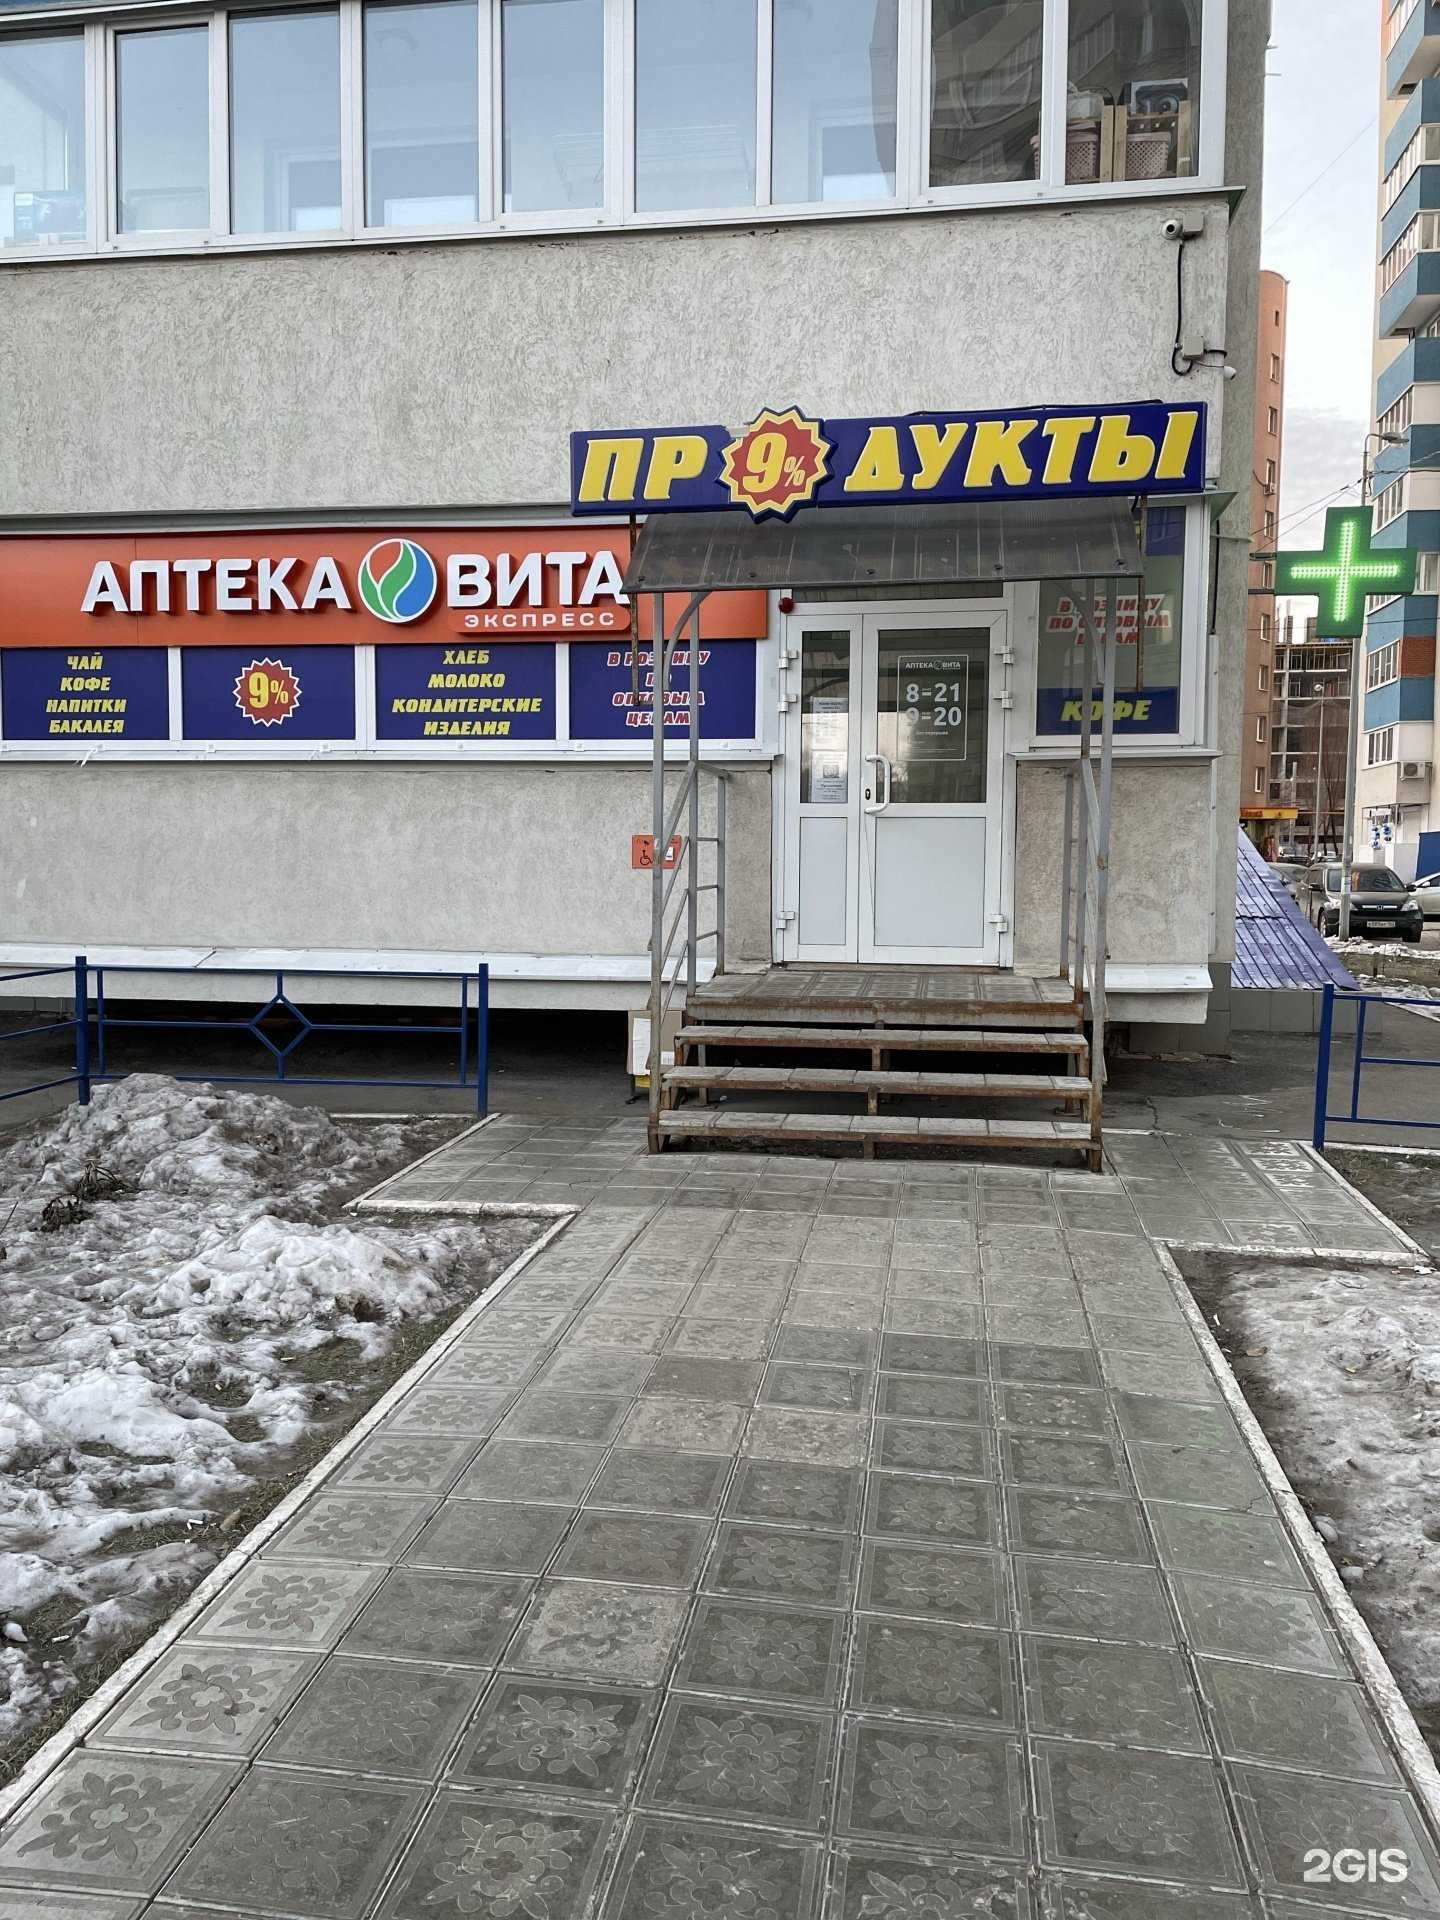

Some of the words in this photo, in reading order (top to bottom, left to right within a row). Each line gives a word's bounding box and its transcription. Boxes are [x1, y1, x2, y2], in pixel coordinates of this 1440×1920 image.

[80, 556, 353, 612] АПТЕКА
[446, 550, 630, 608] ВИТА
[464, 612, 615, 629] ЭКСПРЕСС
[67, 652, 103, 670] ЧАЙ
[442, 649, 490, 665] ХЛЕБ
[607, 652, 621, 666] В
[60, 676, 111, 692] КОФЕ
[427, 672, 506, 689] МОЛОКО
[248, 672, 289, 709] 9%
[46, 698, 127, 714] НАПИТКИ
[391, 696, 542, 714] КОНДИТЕРСКИЕ
[48, 718, 125, 735] БАКАЛЕЯ
[423, 720, 511, 736] ИЗДЕЛИЯ
